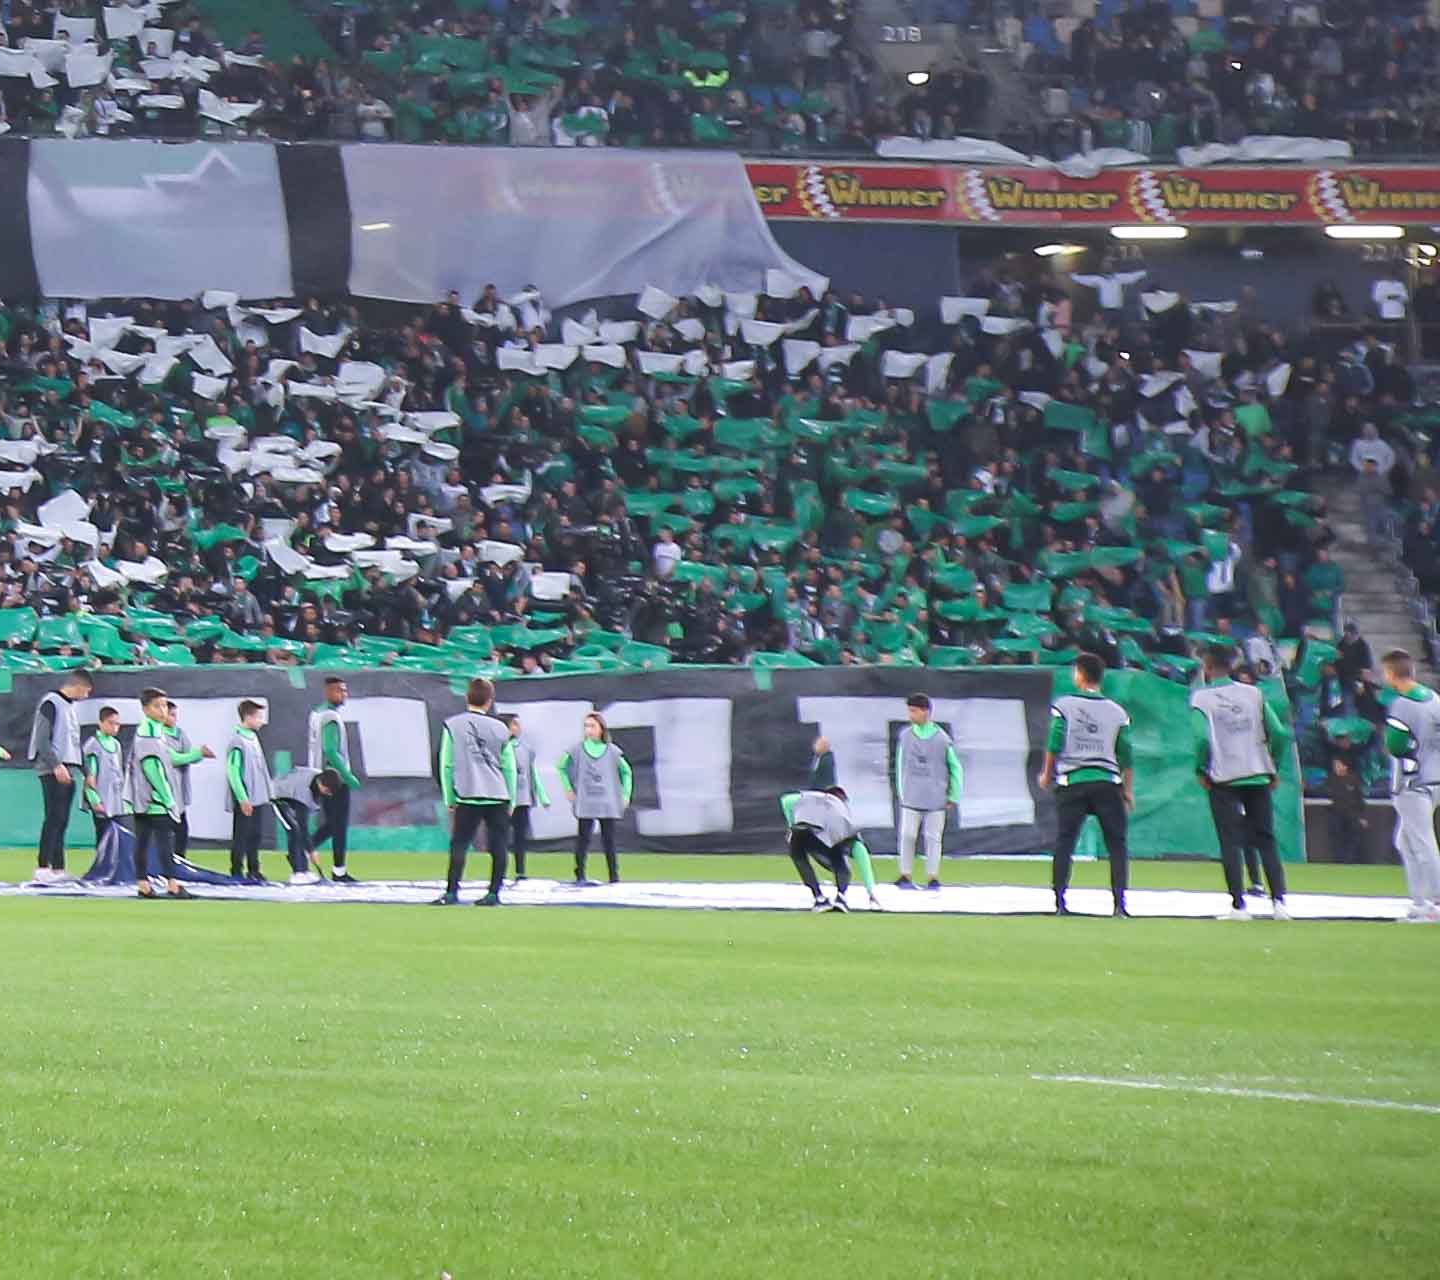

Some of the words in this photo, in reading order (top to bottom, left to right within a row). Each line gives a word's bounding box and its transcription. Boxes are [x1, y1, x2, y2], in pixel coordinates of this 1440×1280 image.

[827, 173, 947, 208] Winner
[988, 177, 1117, 210] Winner
[1162, 178, 1298, 210] Winner
[1342, 179, 1440, 209] Winn
